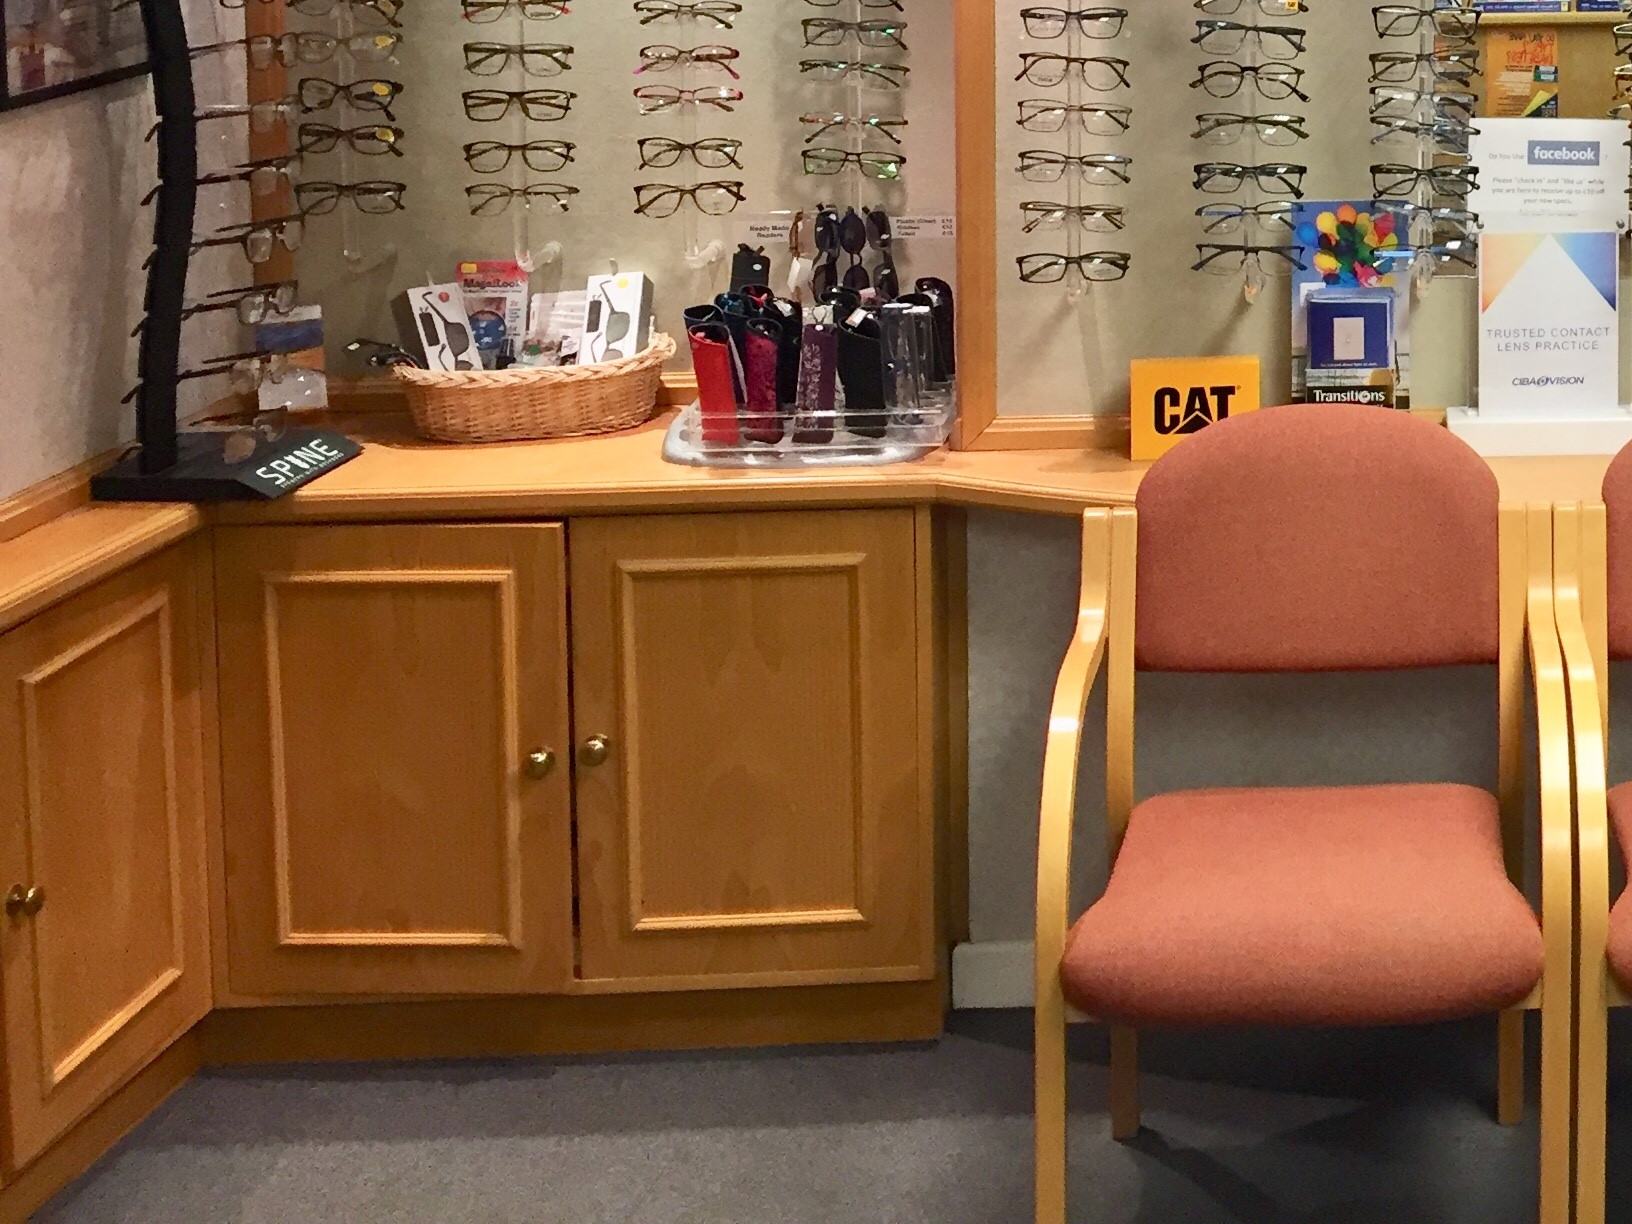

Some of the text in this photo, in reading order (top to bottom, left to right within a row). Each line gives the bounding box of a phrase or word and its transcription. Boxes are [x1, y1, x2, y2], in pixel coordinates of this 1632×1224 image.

[1533, 146, 1596, 160] facebook
[1487, 327, 1610, 338] TRUSTED CONTACT
[1497, 340, 1600, 352] LENS PRACTICE
[1512, 376, 1585, 386] CIBA VISION
[1313, 389, 1386, 403] Transitions
[1154, 385, 1236, 434] CAT
[255, 438, 338, 485] SPINE
